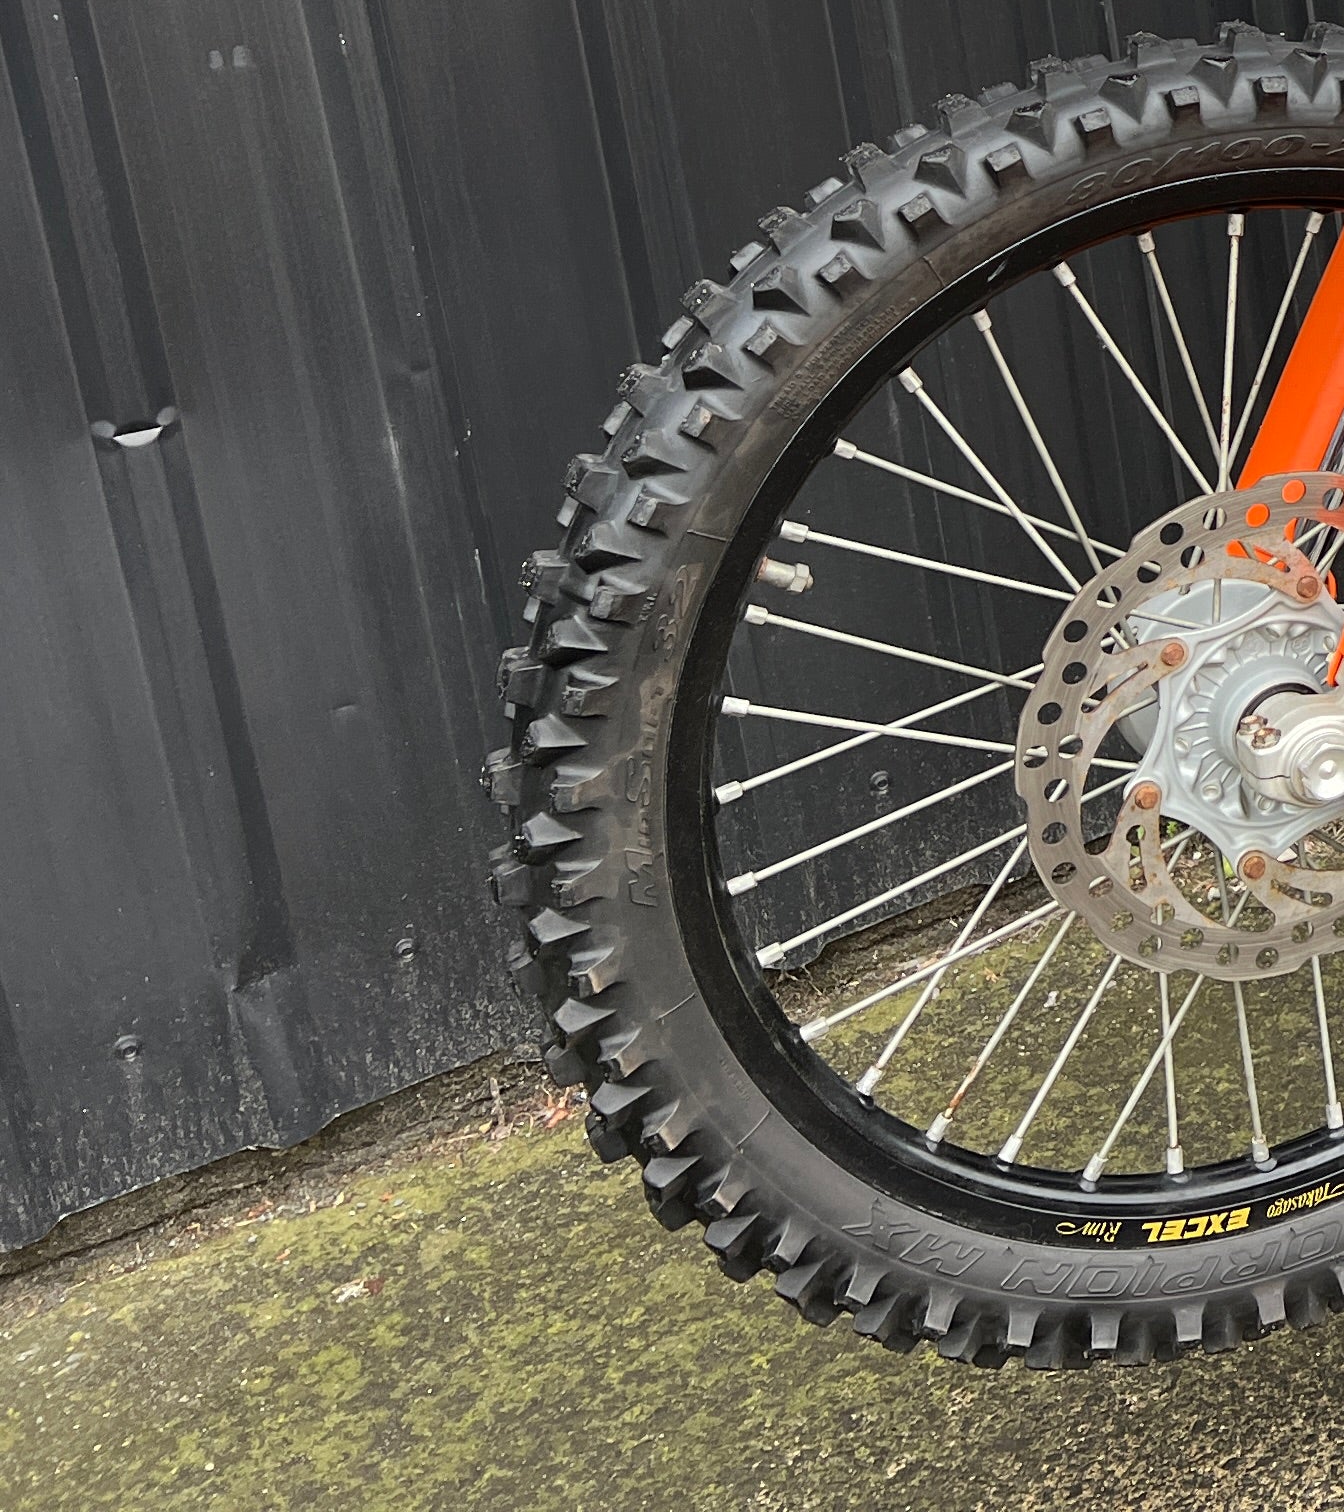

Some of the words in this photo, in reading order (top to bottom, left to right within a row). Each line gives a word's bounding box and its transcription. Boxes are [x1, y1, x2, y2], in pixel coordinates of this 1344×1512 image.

[840, 1201, 986, 1277] MX
[1055, 1220, 1123, 1243] Rim
[1141, 1206, 1252, 1243] EXCEL
